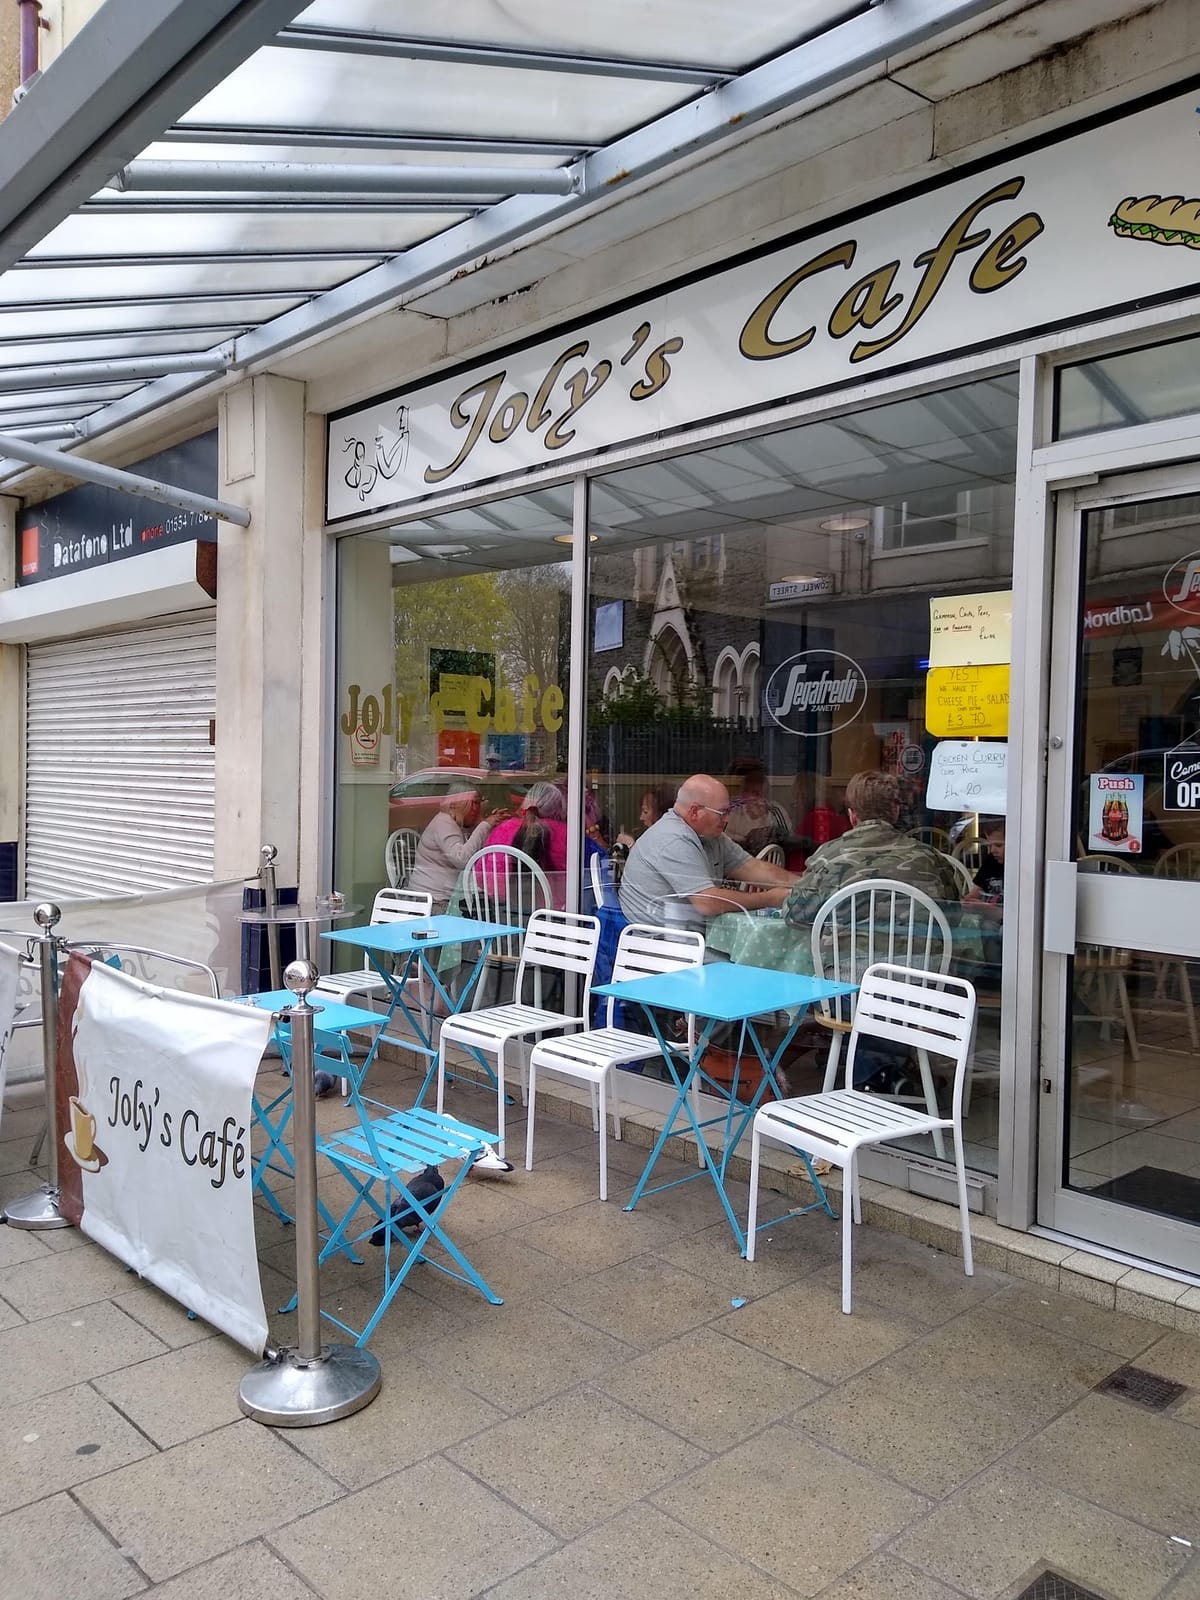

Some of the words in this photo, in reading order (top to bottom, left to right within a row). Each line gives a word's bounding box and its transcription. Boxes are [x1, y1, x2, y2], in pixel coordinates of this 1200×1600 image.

[424, 321, 684, 483] Joly's
[739, 176, 1045, 364] Cafe
[112, 518, 133, 551] Ltd
[465, 673, 564, 734] Cafe
[775, 664, 858, 717] Segafredo
[810, 704, 840, 712] ZANETTI
[1098, 777, 1135, 790] Push
[108, 1076, 172, 1152] Joly's
[180, 1109, 246, 1188] Café
